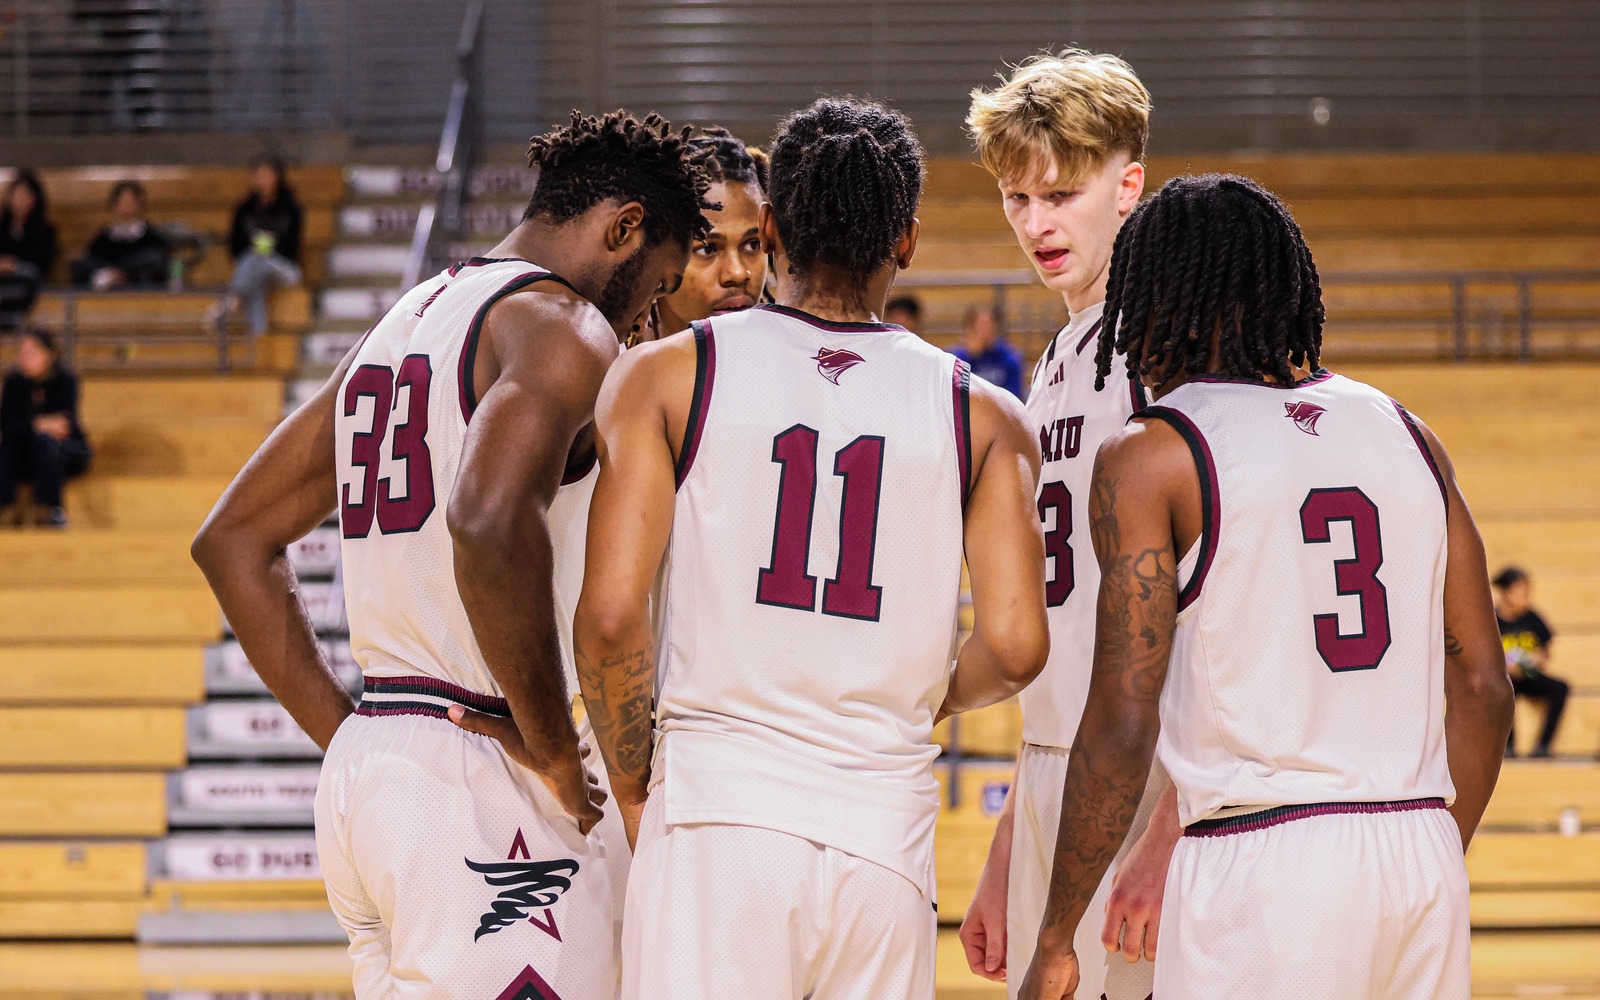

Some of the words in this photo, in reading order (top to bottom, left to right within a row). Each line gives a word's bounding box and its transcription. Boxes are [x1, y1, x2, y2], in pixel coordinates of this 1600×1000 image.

[342, 353, 436, 539] 33
[755, 423, 886, 622] 11
[1299, 486, 1392, 673] 3
